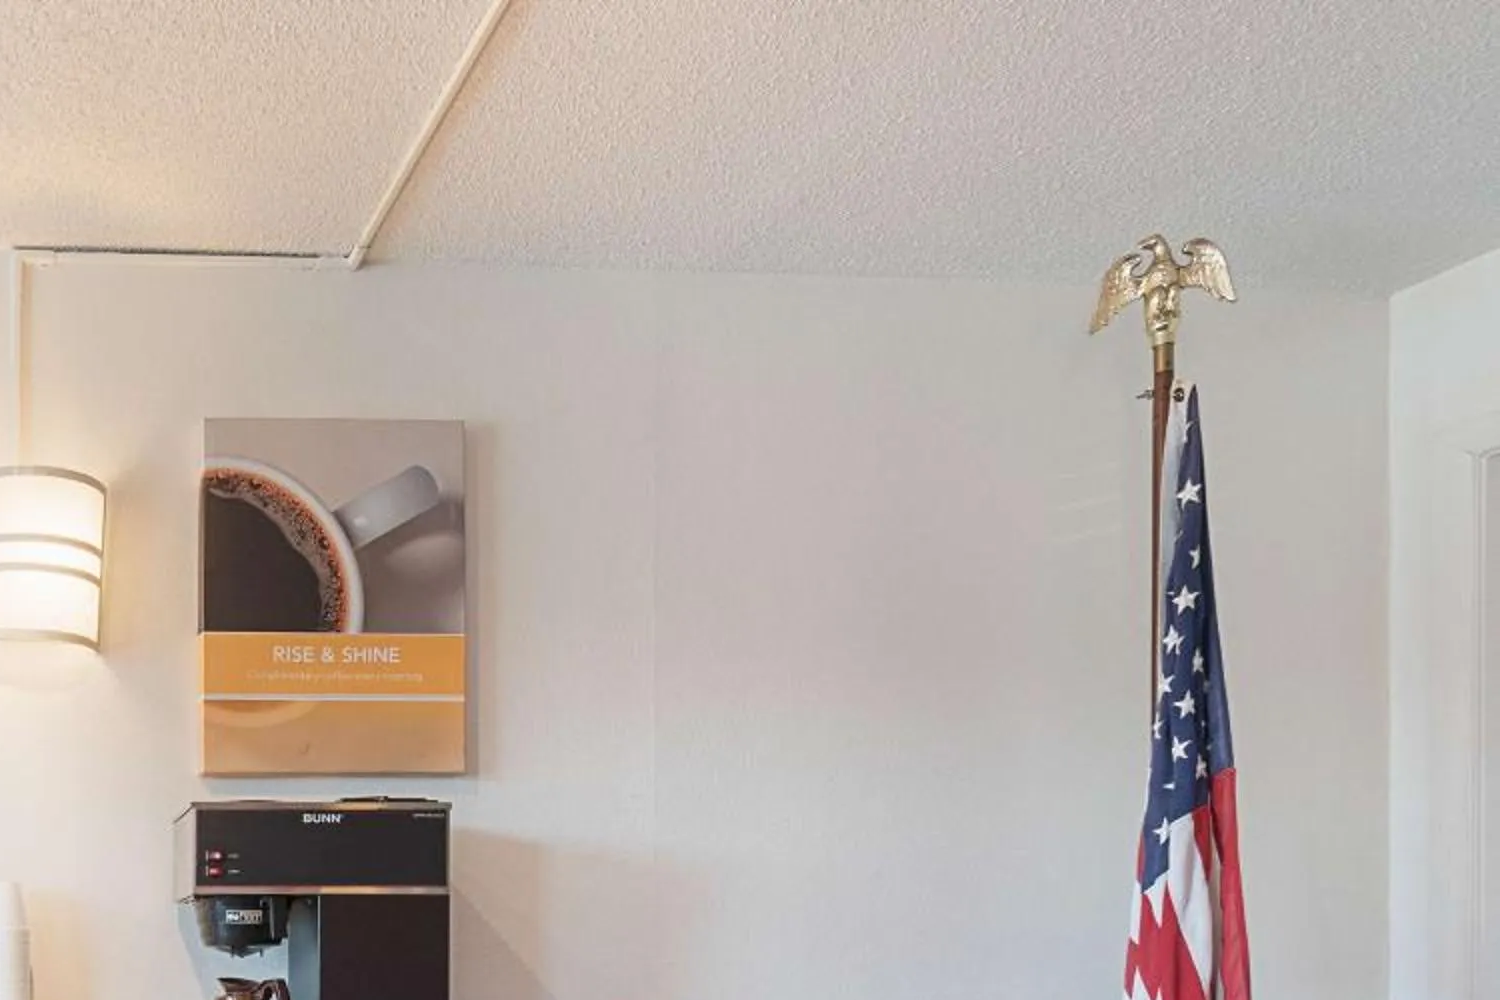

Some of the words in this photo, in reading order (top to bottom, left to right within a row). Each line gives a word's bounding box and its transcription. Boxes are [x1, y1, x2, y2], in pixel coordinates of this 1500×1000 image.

[273, 646, 316, 663] RISE
[321, 647, 335, 663] &
[342, 648, 401, 664] SHINE
[303, 813, 340, 824] BUNN
